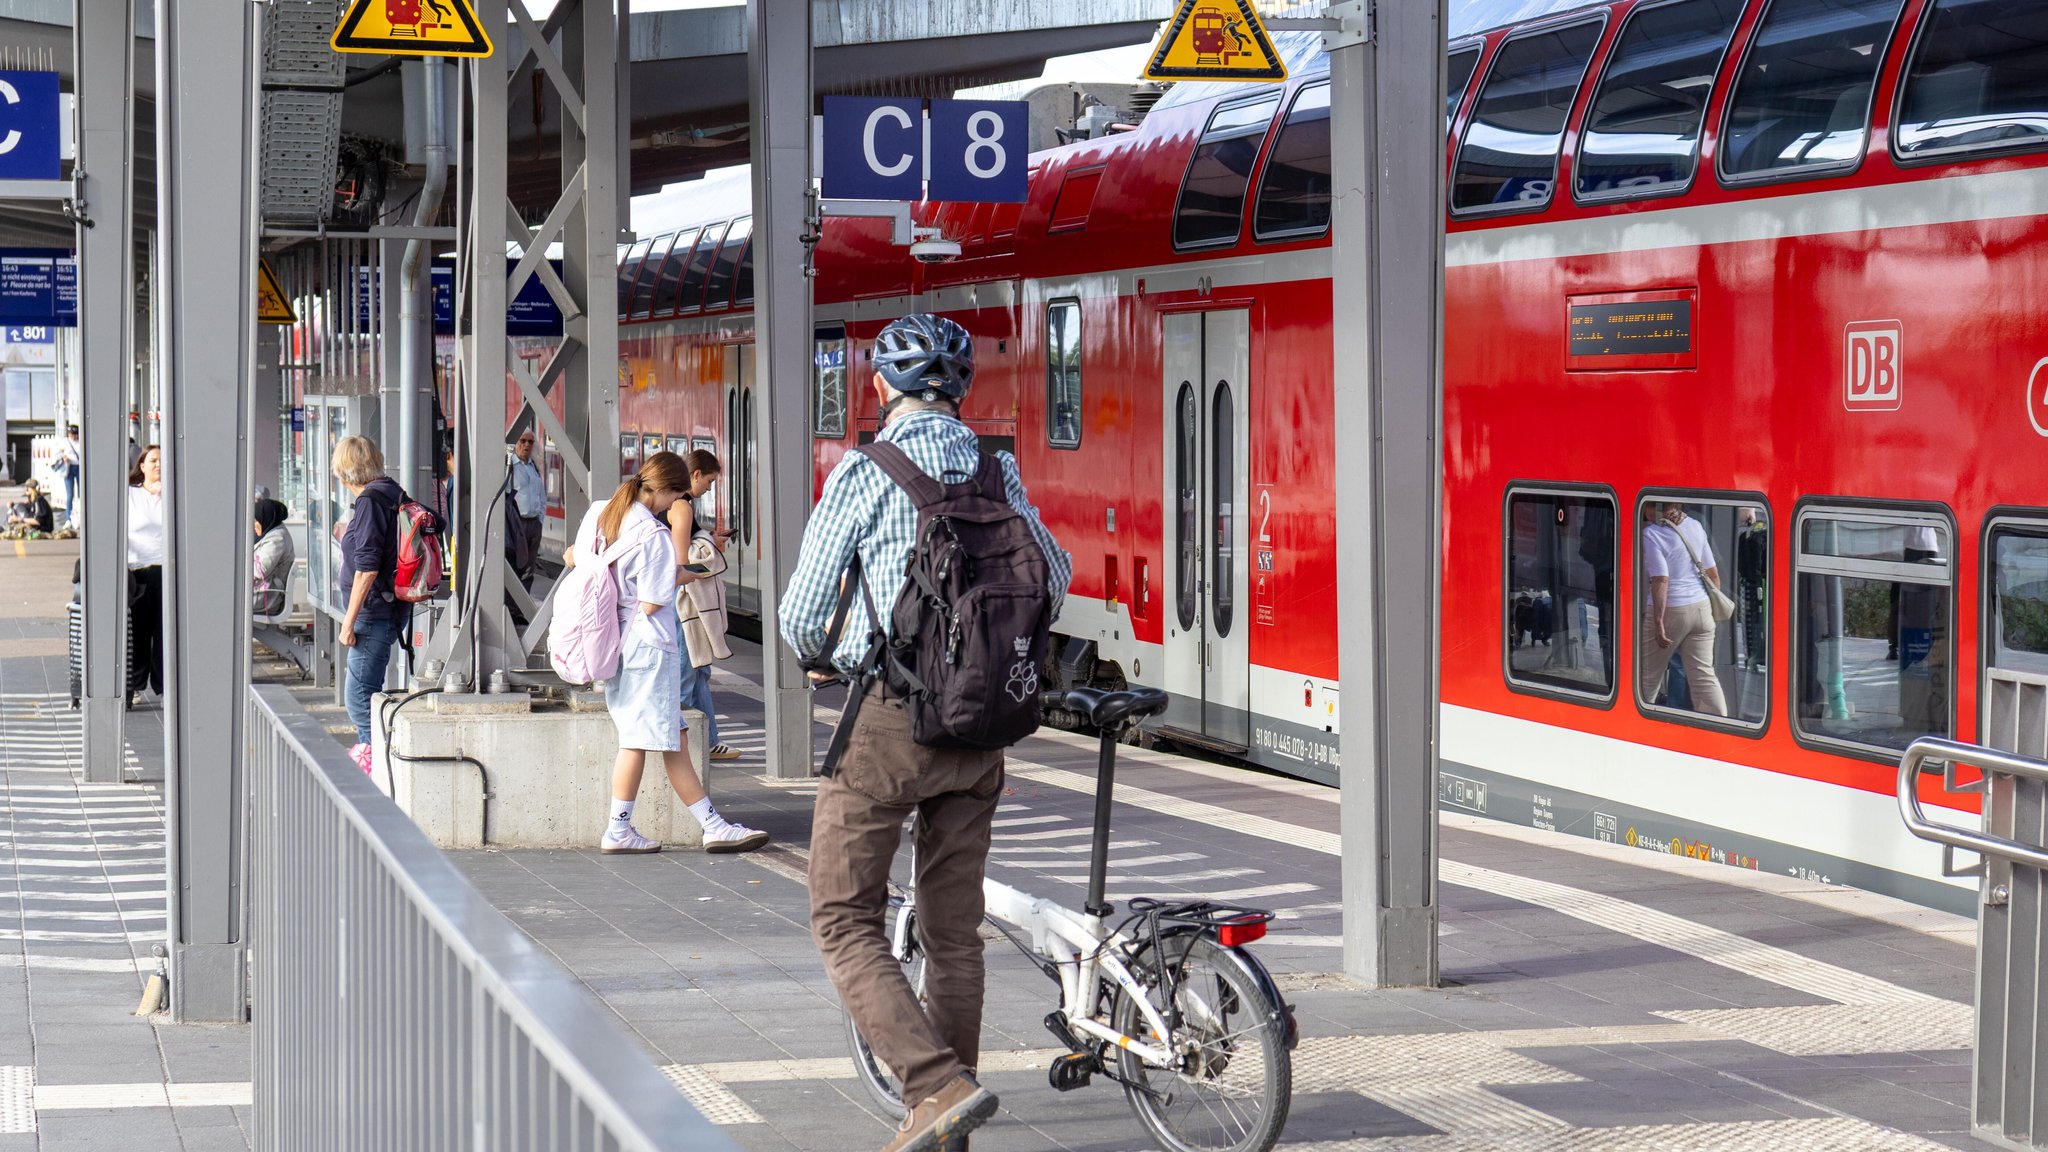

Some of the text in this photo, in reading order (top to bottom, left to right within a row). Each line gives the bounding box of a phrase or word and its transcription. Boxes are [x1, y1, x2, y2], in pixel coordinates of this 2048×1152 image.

[863, 106, 1007, 179] C 8
[23, 326, 45, 340] 801
[1852, 336, 1895, 395] DB
[1259, 489, 1271, 542] 2
[1278, 733, 1291, 753] 445
